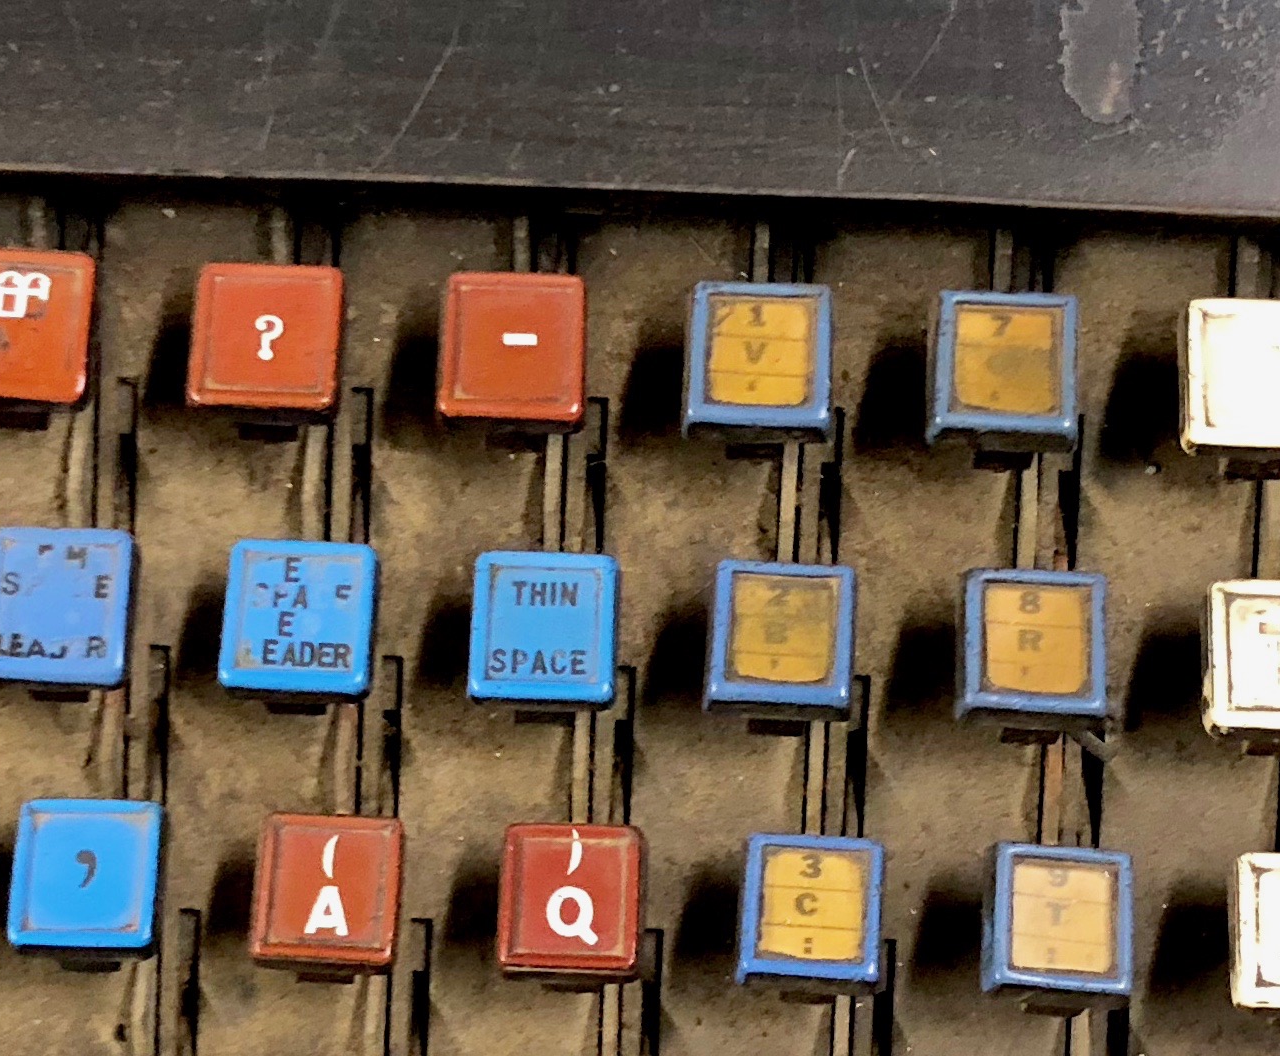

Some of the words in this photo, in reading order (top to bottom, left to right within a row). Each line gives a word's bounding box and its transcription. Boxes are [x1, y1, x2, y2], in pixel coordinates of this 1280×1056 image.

[255, 314, 284, 361] ?
[511, 580, 580, 608] THIN
[261, 638, 352, 668] EADER
[488, 647, 588, 676] SPACE
[303, 885, 350, 937] A
[545, 885, 599, 947] Q
